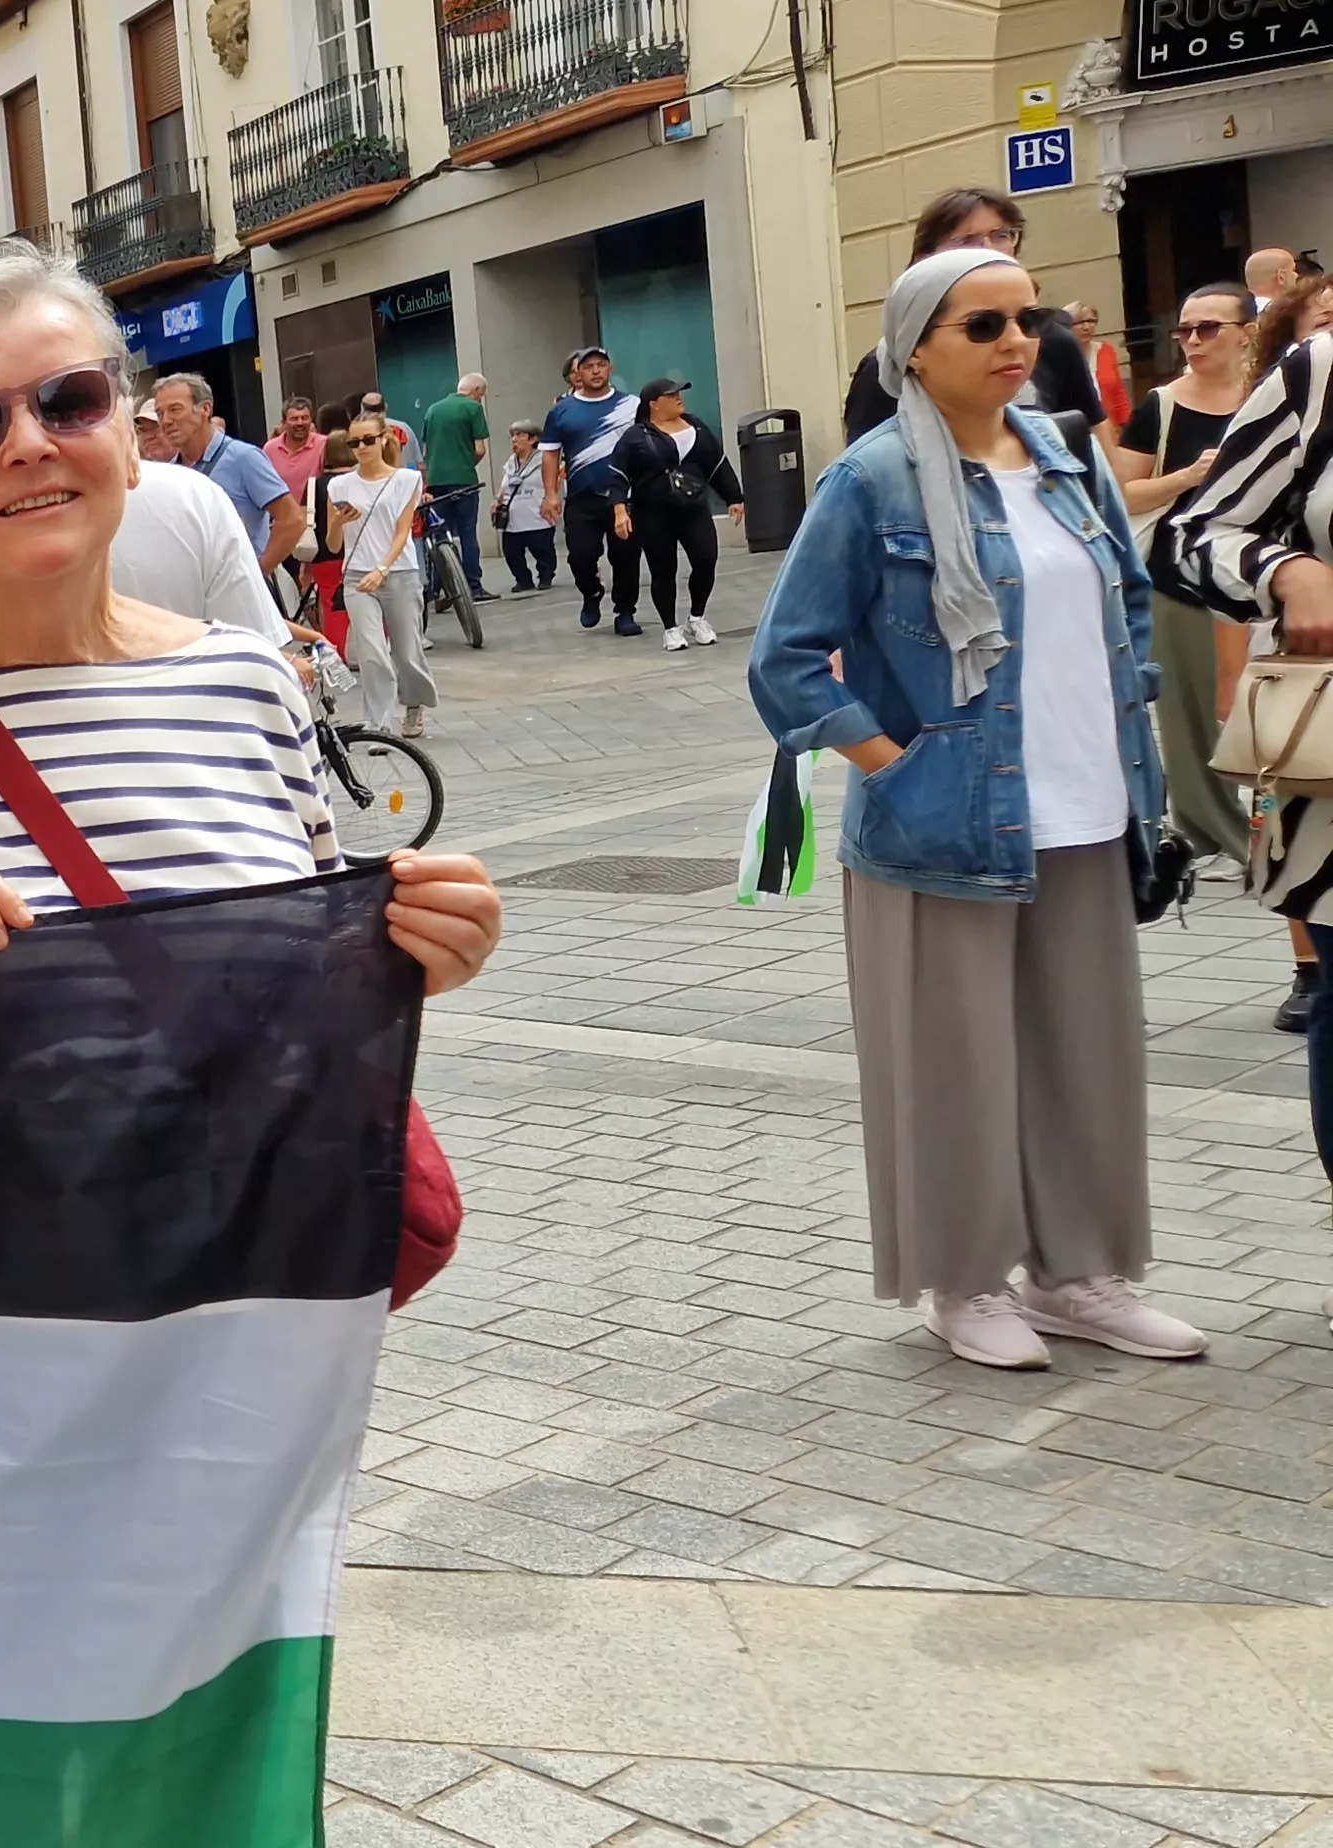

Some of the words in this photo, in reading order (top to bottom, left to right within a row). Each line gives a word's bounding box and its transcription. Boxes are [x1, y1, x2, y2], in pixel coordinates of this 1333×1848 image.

[1150, 18, 1320, 64] HOSTA
[1014, 134, 1065, 170] HS
[396, 283, 452, 315] CaixaBank
[119, 322, 141, 337] IGI
